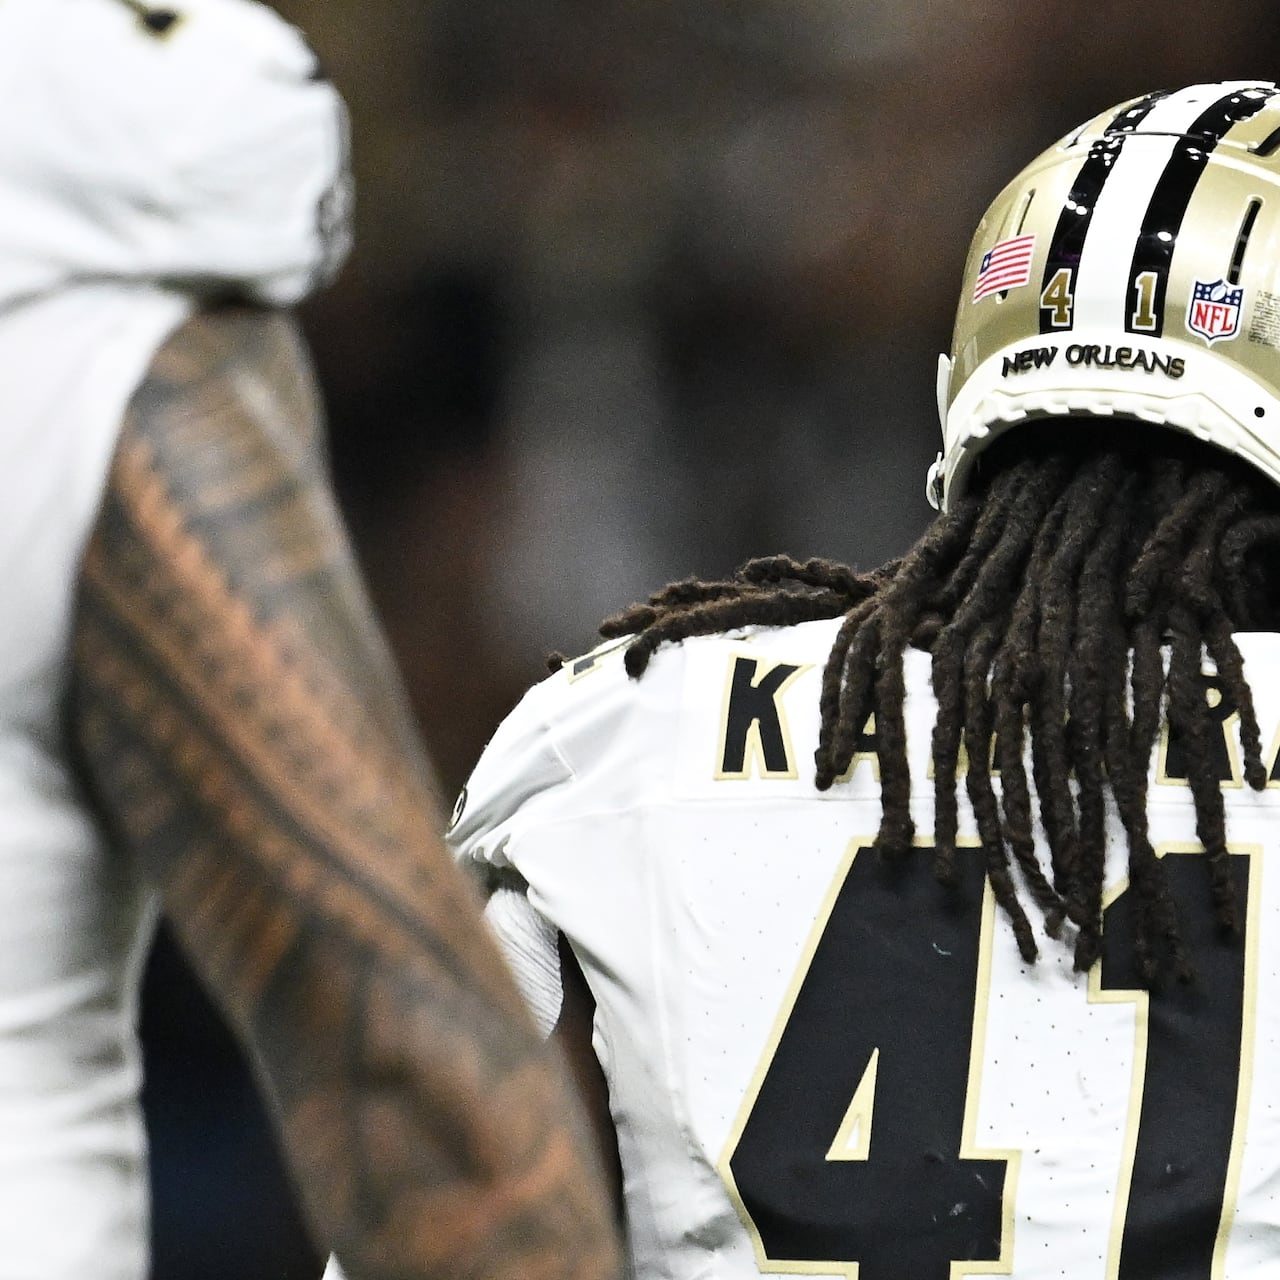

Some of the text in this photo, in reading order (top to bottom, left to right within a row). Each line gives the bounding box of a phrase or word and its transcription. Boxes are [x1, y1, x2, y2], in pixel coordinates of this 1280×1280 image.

[1193, 302, 1234, 334] NFL
[1001, 344, 1186, 380] NEW ORLEANS
